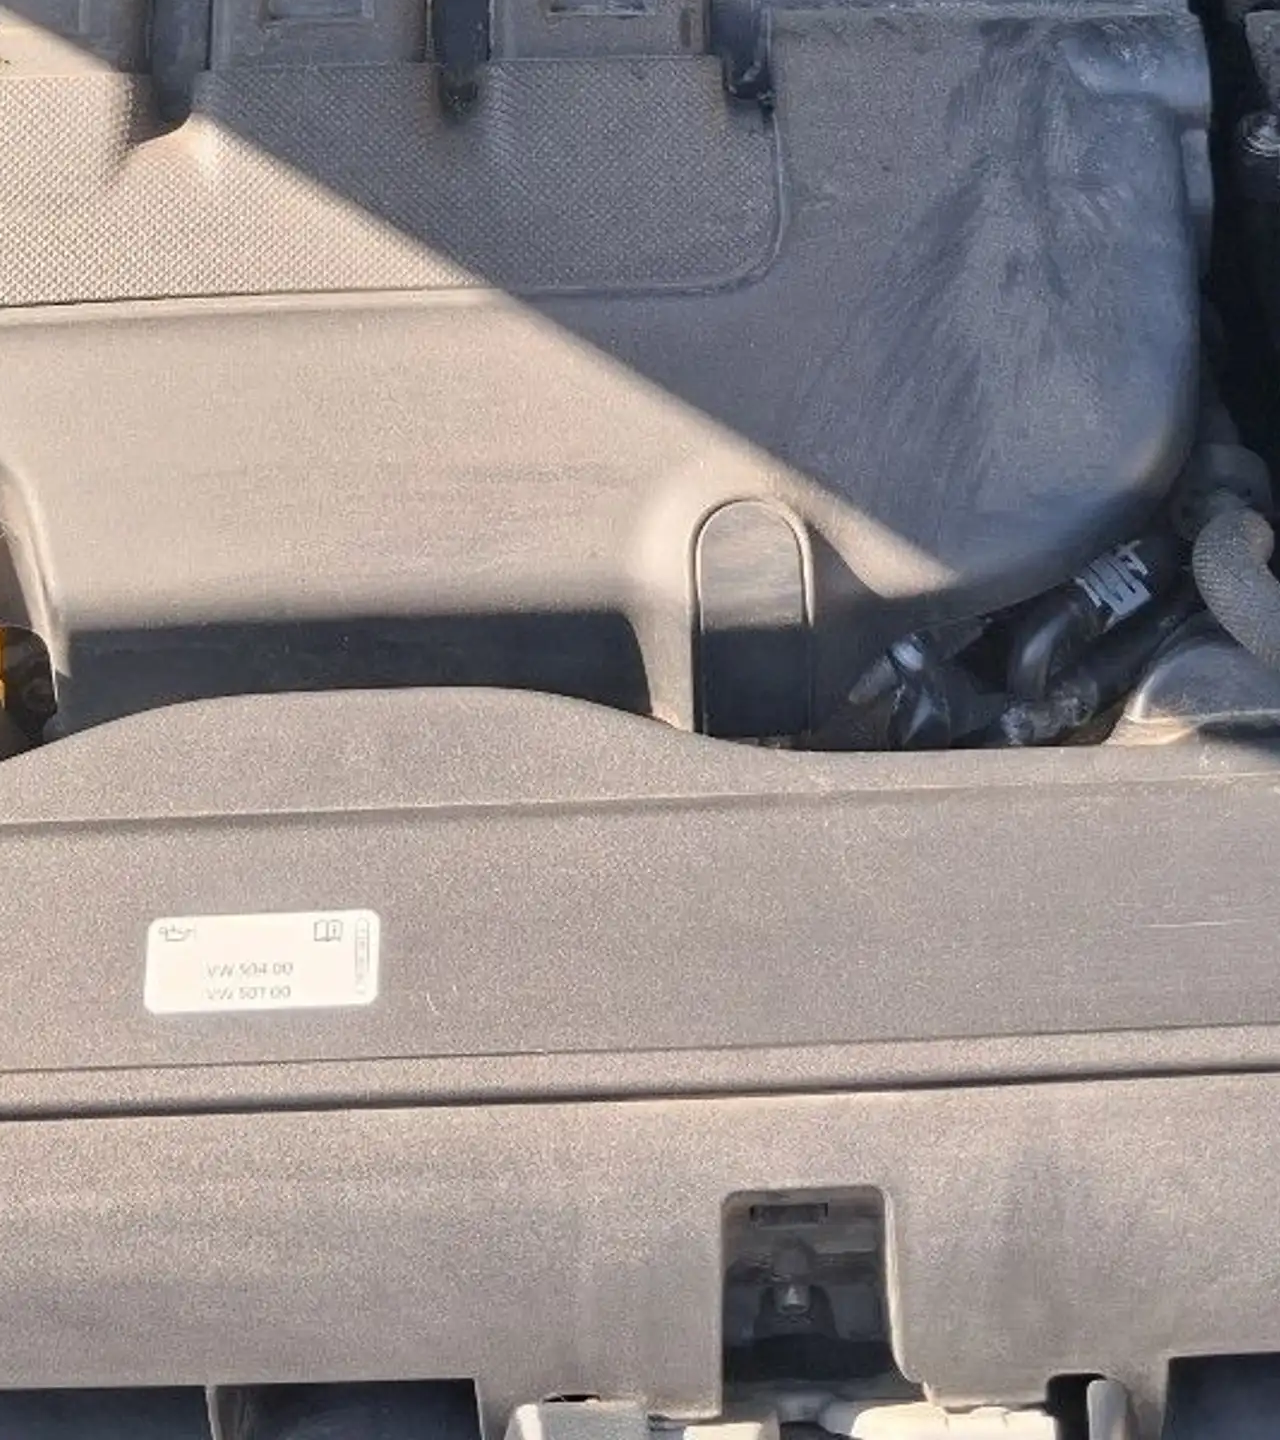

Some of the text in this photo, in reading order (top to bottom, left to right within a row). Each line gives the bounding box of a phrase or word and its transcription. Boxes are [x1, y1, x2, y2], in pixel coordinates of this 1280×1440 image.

[207, 962, 294, 978] VW 504 00
[270, 985, 291, 999] 00
